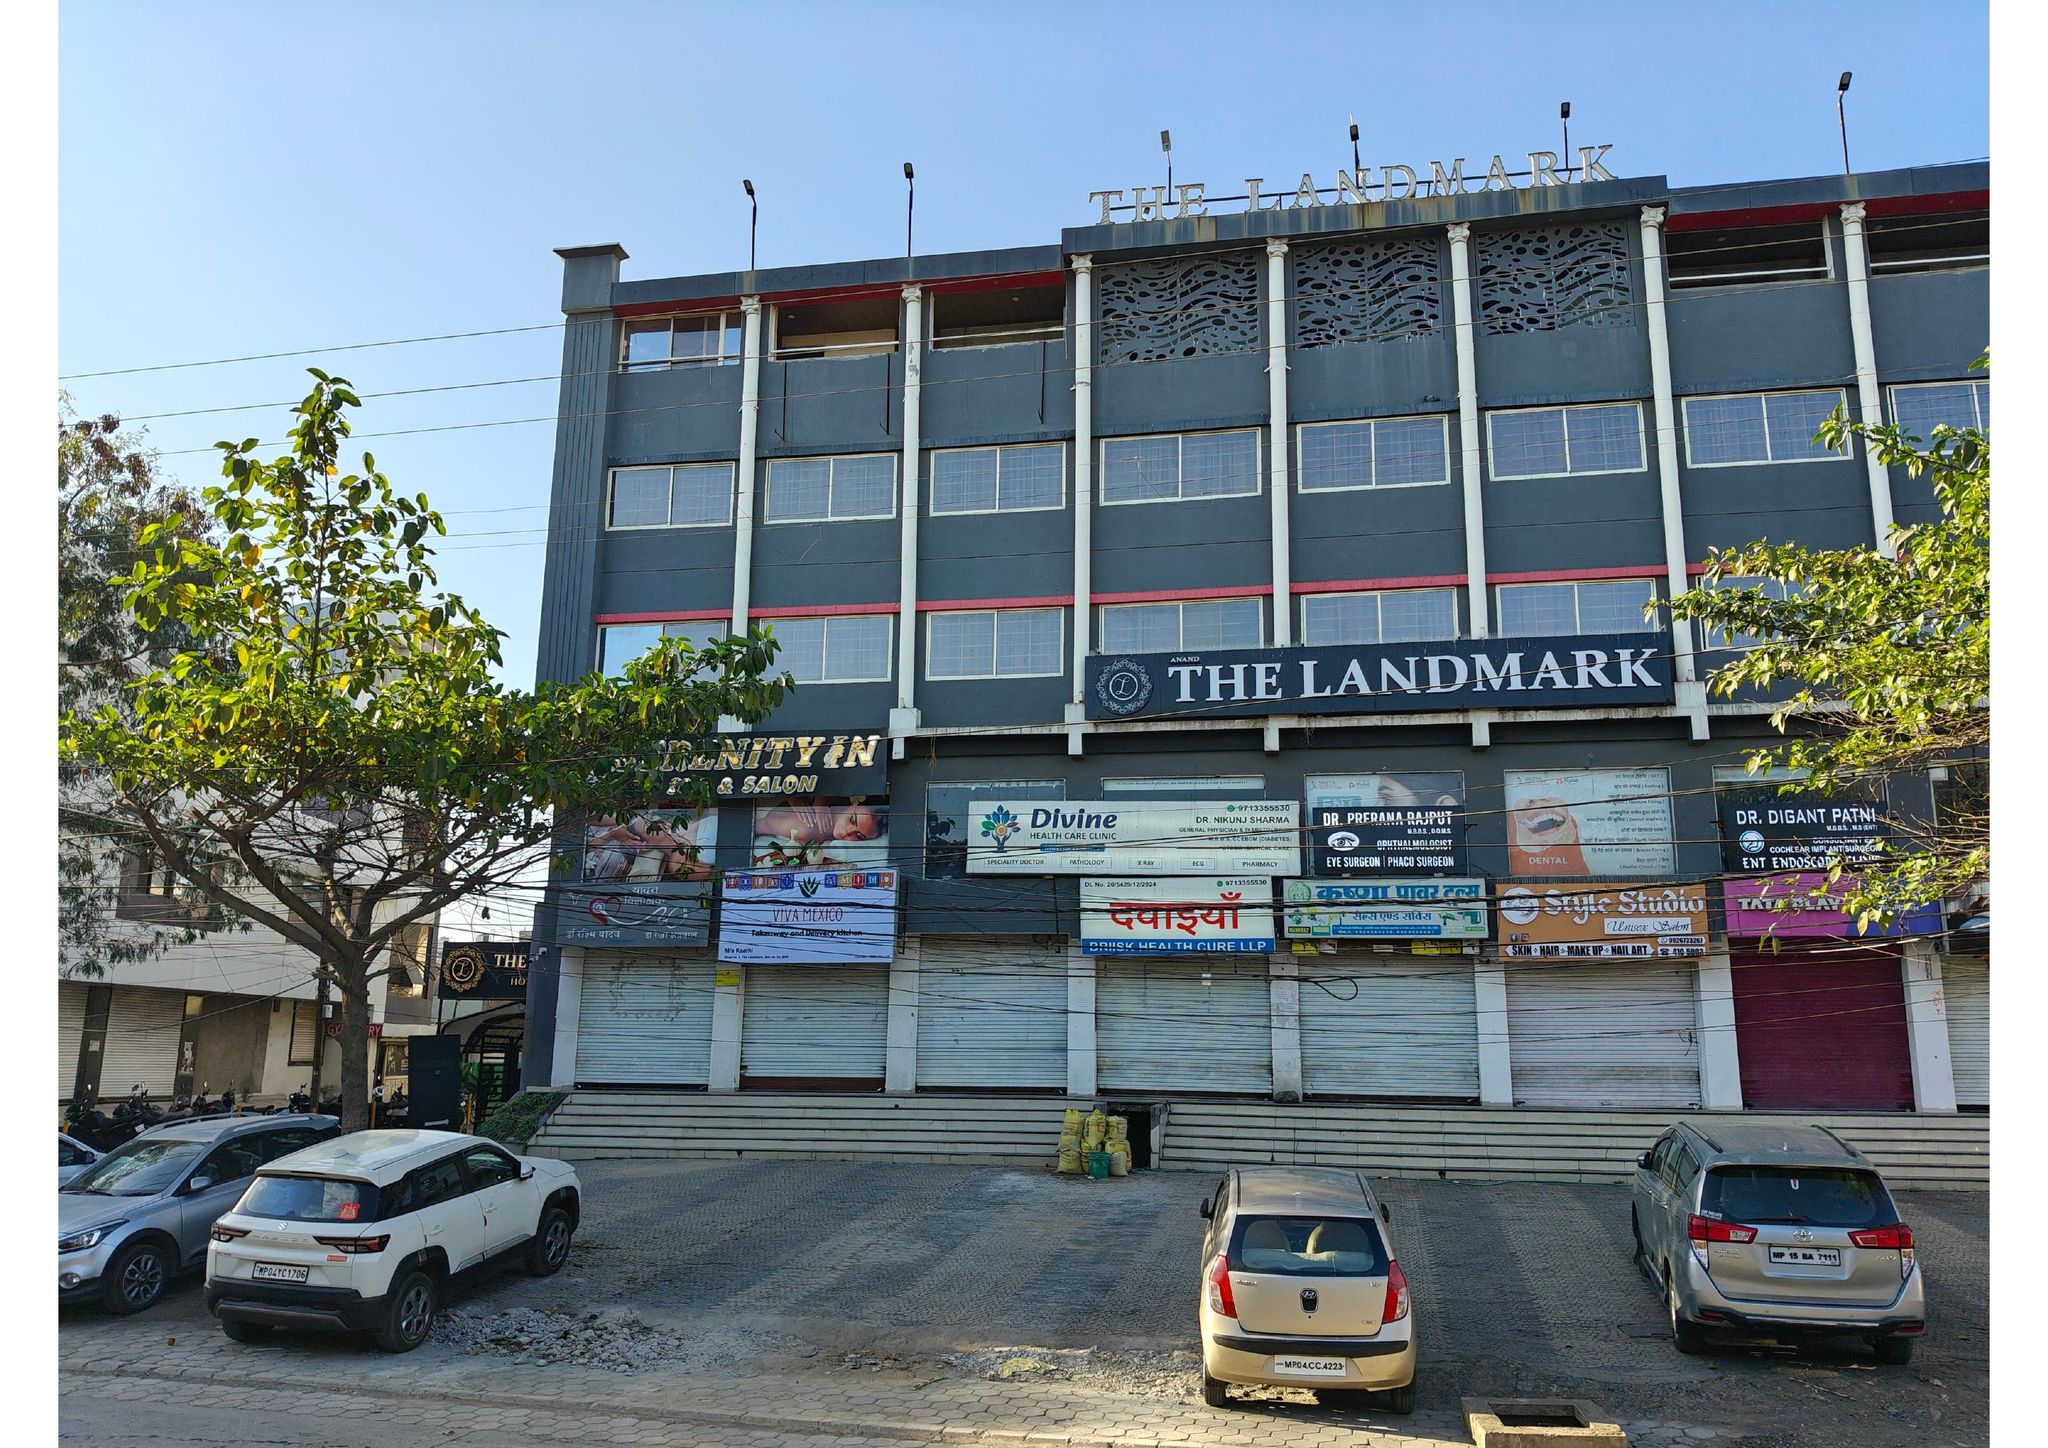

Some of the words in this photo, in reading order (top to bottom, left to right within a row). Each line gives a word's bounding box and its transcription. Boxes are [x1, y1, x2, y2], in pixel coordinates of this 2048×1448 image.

[1089, 183, 1208, 226] THE
[1244, 144, 1619, 213] LANDMARK
[1167, 662, 1282, 703] THE
[1299, 648, 1662, 698] LANDMARK
[741, 775, 819, 795] SALON
[1238, 804, 1290, 812] 9713355530
[1031, 808, 1118, 829] Divine
[1196, 816, 1211, 824] DR.
[1213, 816, 1248, 824] NIKUNJ
[1249, 816, 1290, 824] SHARMA
[1323, 812, 1343, 826] DR.
[1407, 811, 1453, 826] RAJPUT
[1736, 810, 1762, 825] DR.
[1768, 808, 1826, 824] DIGANT
[1832, 807, 1876, 823] PATNI
[1030, 832, 1062, 840] HEALTH
[1064, 832, 1087, 840] CARE
[1088, 832, 1117, 840] CLINIC
[1376, 840, 1453, 850] OPHTHALMOLOGIST
[1326, 856, 1342, 867] EYE
[1343, 856, 1381, 867] SURGEON
[1387, 856, 1415, 867] PHACO
[1416, 856, 1454, 867] SURGEON
[1743, 857, 1767, 869] ENT
[1395, 885, 1439, 900] पावर
[1109, 891, 1242, 936] दवाइयाँ
[1543, 889, 1611, 925] Style
[1617, 889, 1704, 915] Studio
[773, 908, 800, 922] VIVA
[801, 907, 844, 922] MEXICO
[805, 929, 836, 938] Delivery
[1607, 921, 1649, 932] Unisex
[1652, 920, 1690, 933] Salon
[1138, 941, 1193, 951] HEALTH
[1197, 941, 1237, 951] CURE
[1239, 941, 1267, 951] LLP
[1511, 945, 1533, 956] SKIN
[1539, 945, 1560, 955] HAIR
[1567, 945, 1591, 956] MAKE
[1592, 945, 1604, 955] UP
[1611, 944, 1631, 955] NAIL
[1631, 944, 1648, 955] ART
[494, 954, 527, 968] THE
[1772, 1251, 1785, 1259] MP
[1789, 1252, 1799, 1260] 15
[1801, 1252, 1814, 1260] BA
[1817, 1253, 1838, 1261] 7111
[258, 1266, 307, 1280] MP04YC1706
